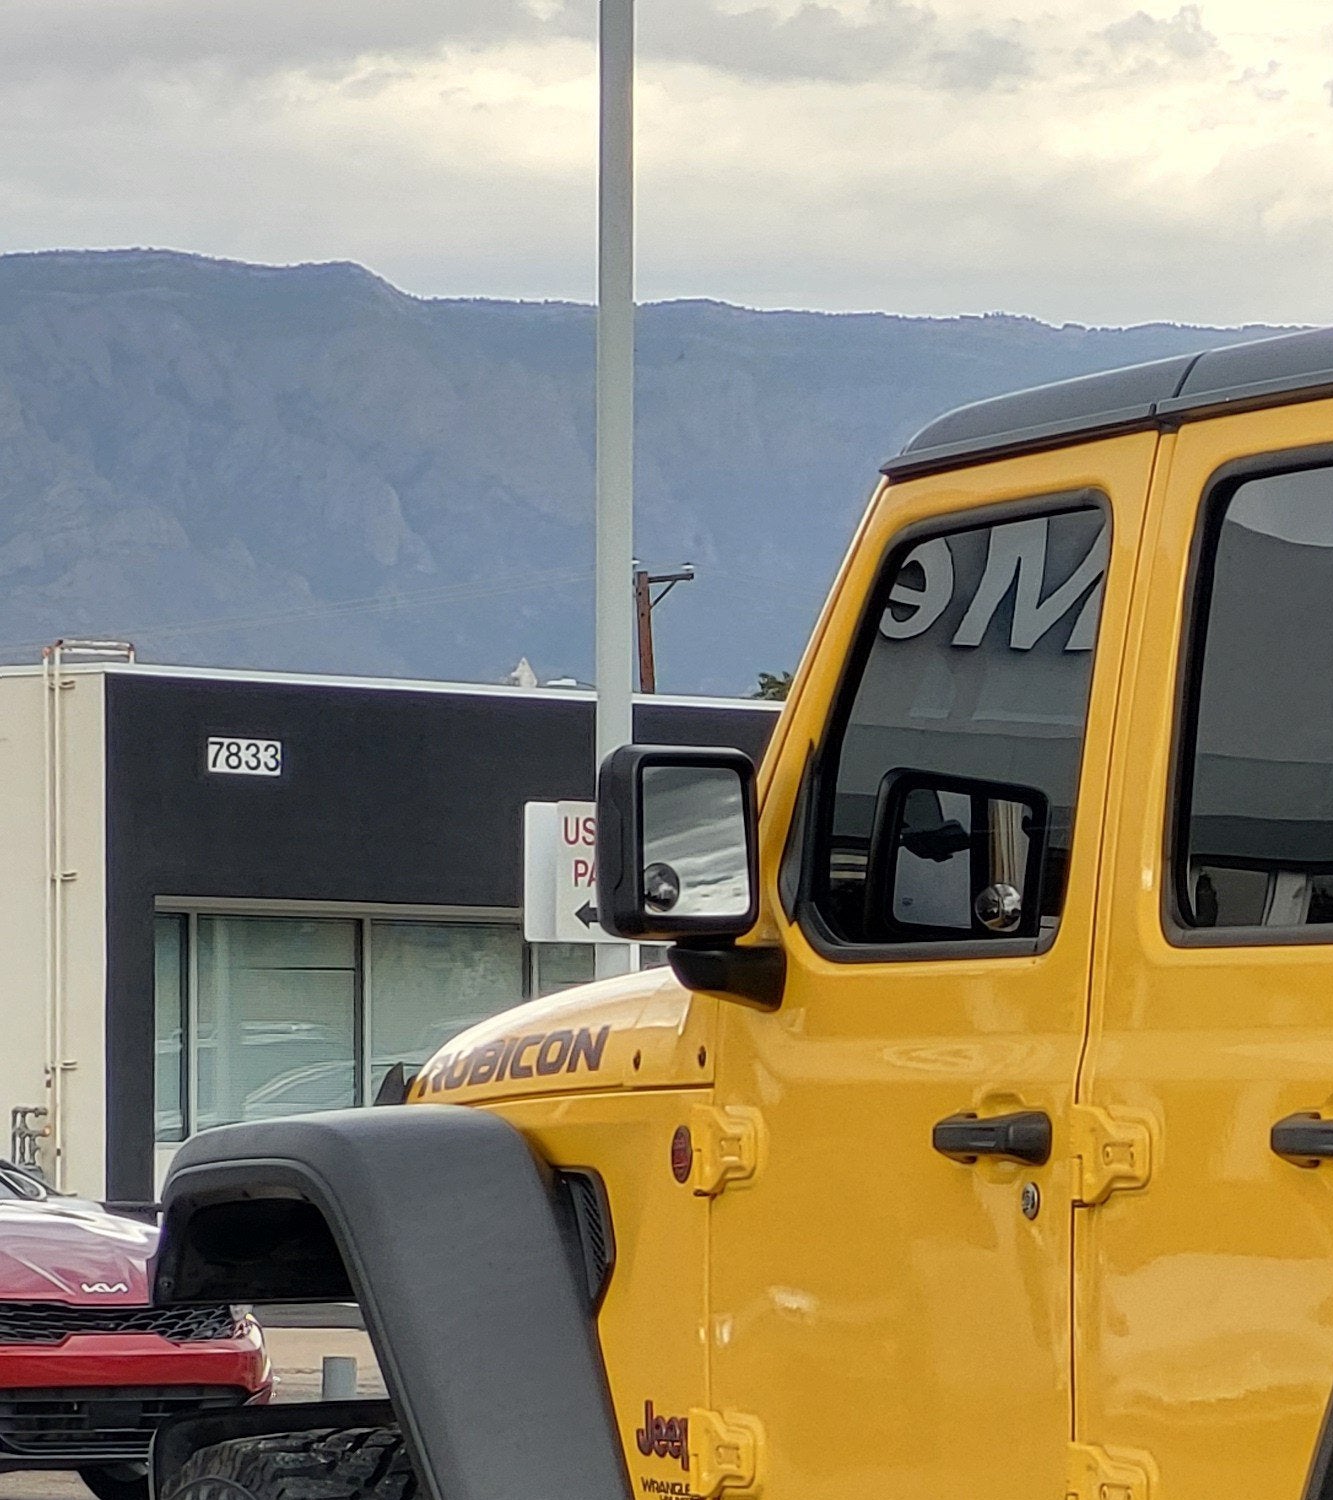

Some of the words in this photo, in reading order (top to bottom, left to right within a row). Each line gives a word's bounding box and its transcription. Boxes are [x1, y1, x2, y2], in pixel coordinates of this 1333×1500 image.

[209, 740, 281, 773] 7833
[564, 816, 597, 846] US
[417, 1025, 611, 1098] RUBICON
[641, 1476, 690, 1496] WRANGLE
